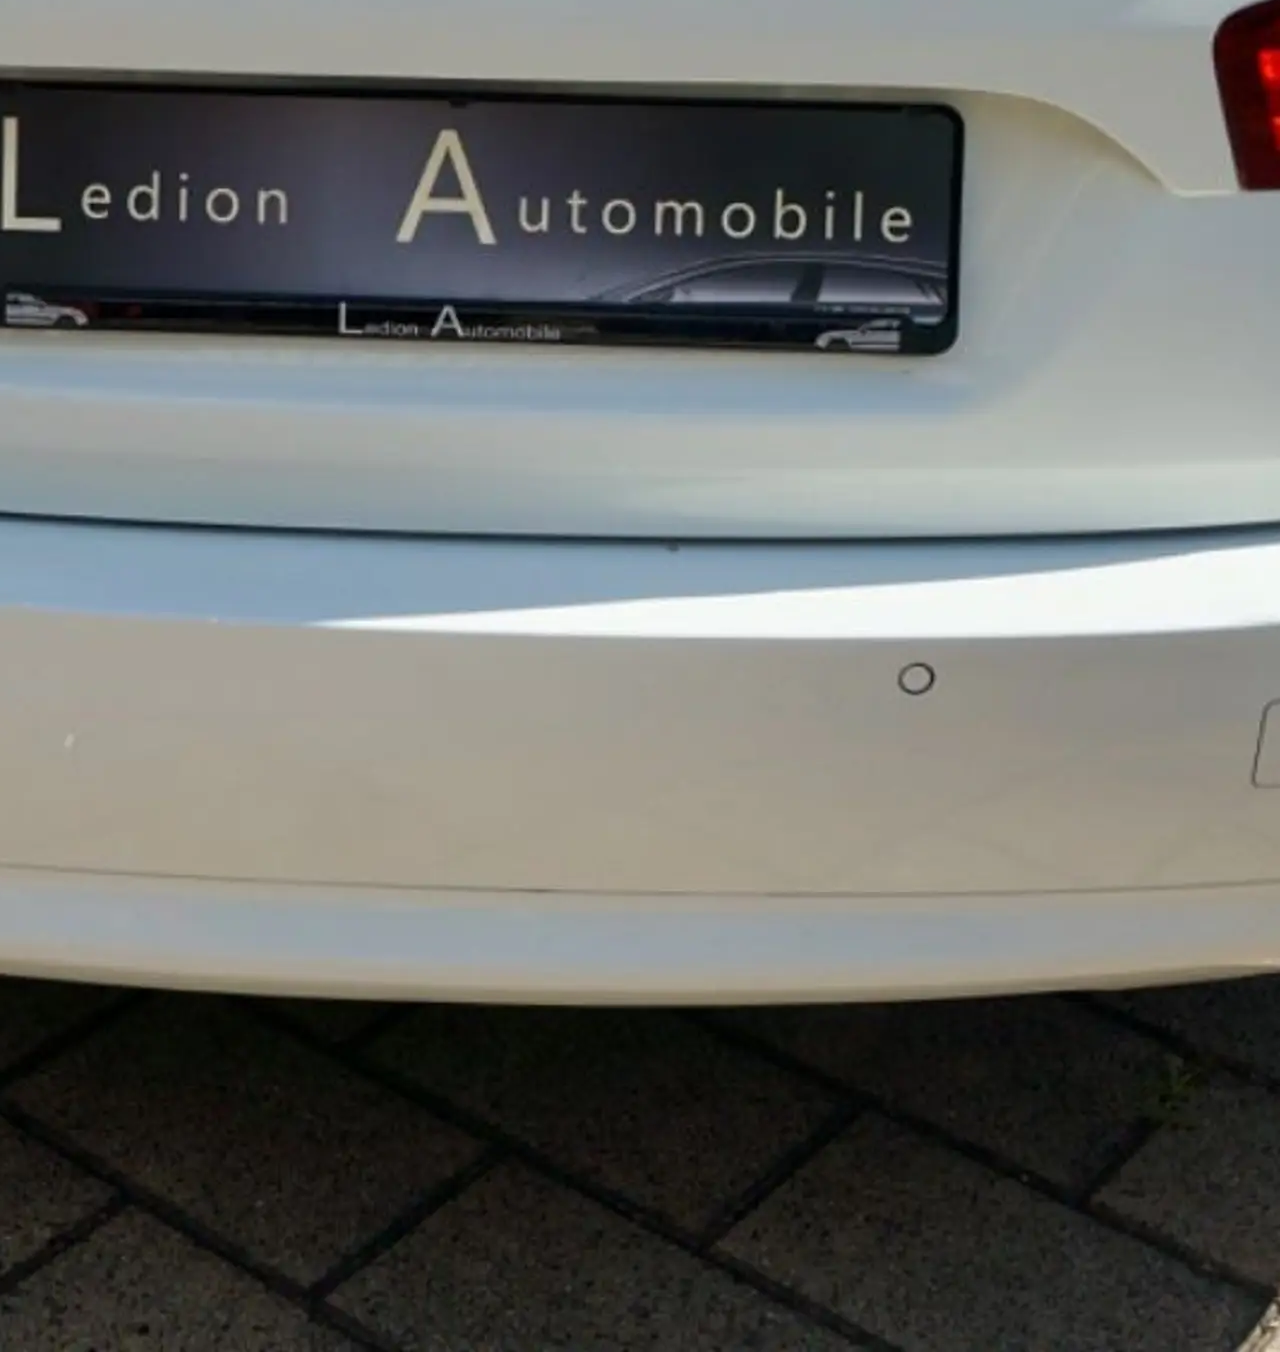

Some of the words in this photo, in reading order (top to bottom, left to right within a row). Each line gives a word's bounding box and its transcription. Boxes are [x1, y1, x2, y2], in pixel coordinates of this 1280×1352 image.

[1, 116, 288, 232] Ledion
[395, 128, 913, 245] Automobile
[338, 301, 418, 336] Ledion
[431, 305, 560, 340] Automobile
